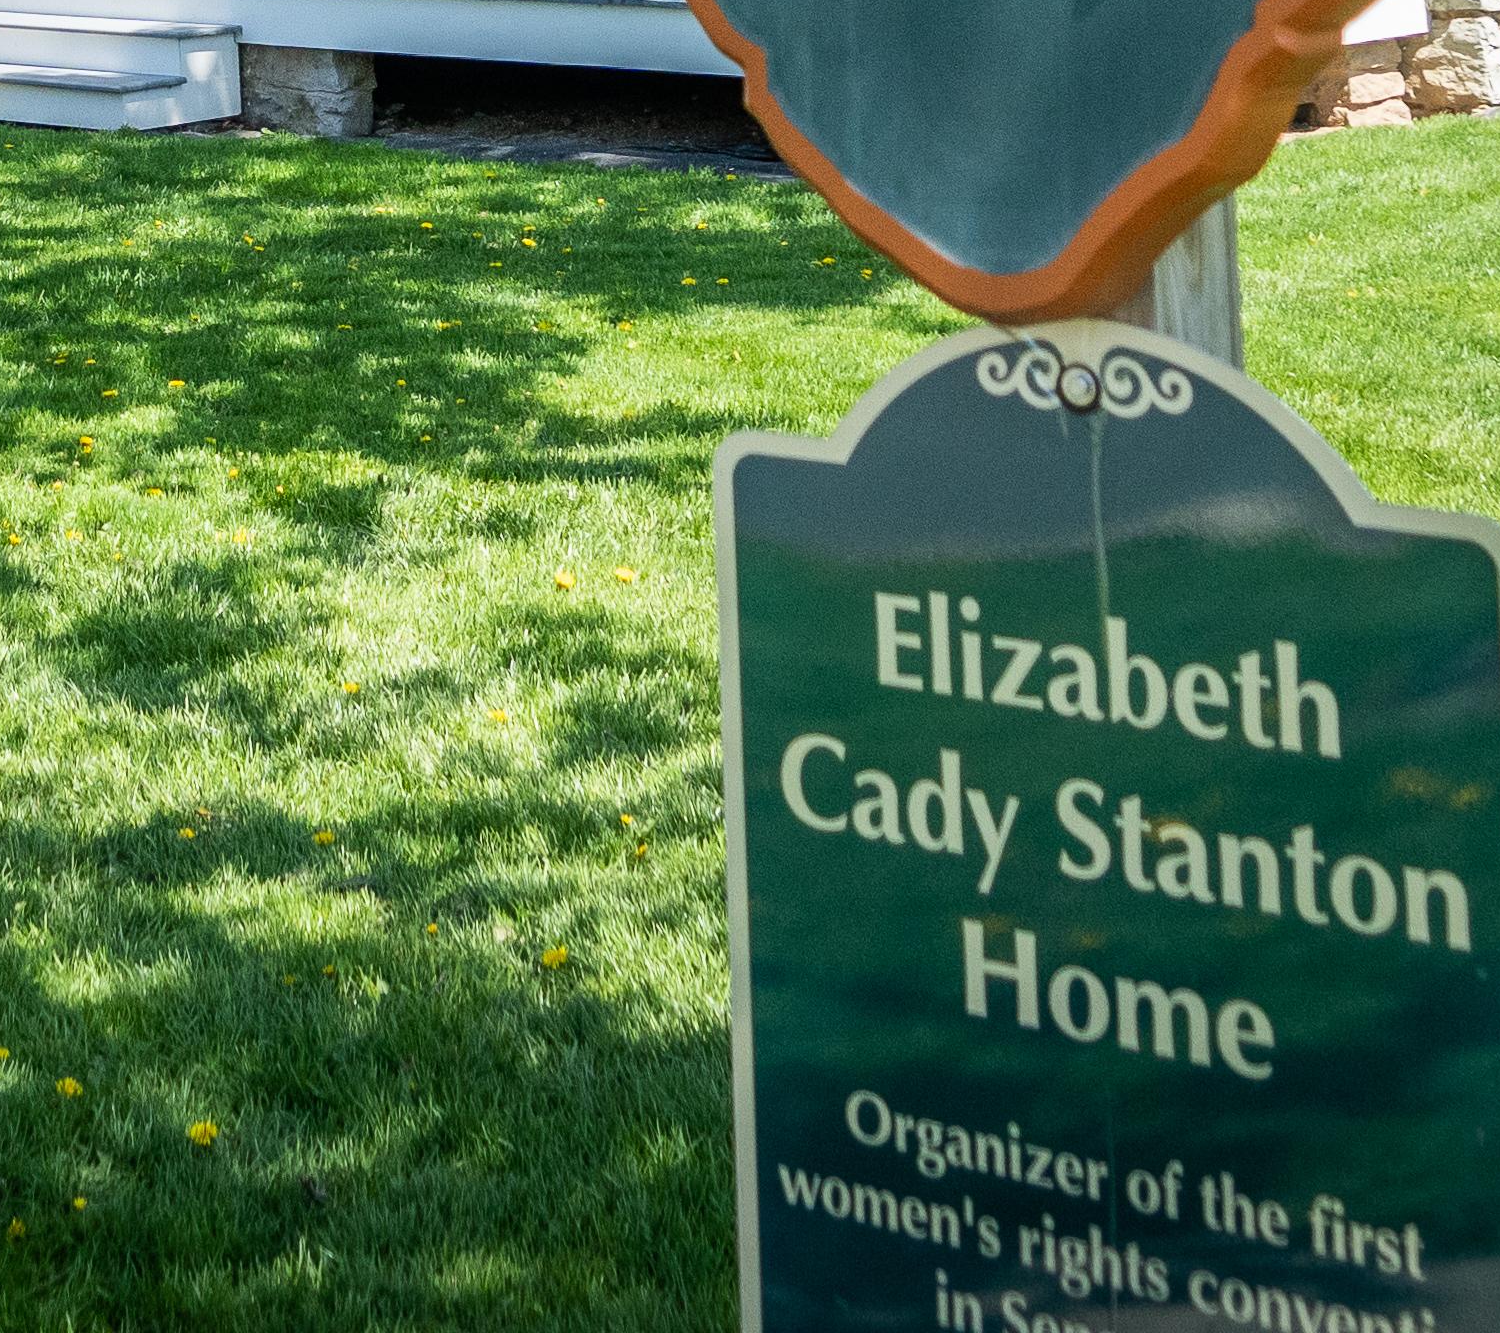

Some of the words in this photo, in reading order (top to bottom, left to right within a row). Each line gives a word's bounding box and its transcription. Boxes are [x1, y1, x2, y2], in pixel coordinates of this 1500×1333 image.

[875, 592, 1340, 758] Elizabeth
[780, 733, 1019, 894] Cady
[1056, 778, 1470, 951] Stanton
[962, 918, 1274, 1079] Home
[779, 1165, 1001, 1257] women's
[1020, 1215, 1169, 1301] rights
[845, 1090, 1108, 1200] Organizer
[1127, 1160, 1183, 1219] of
[1201, 1174, 1290, 1246] the
[1309, 1195, 1428, 1282] first
[937, 1269, 983, 1333] in
